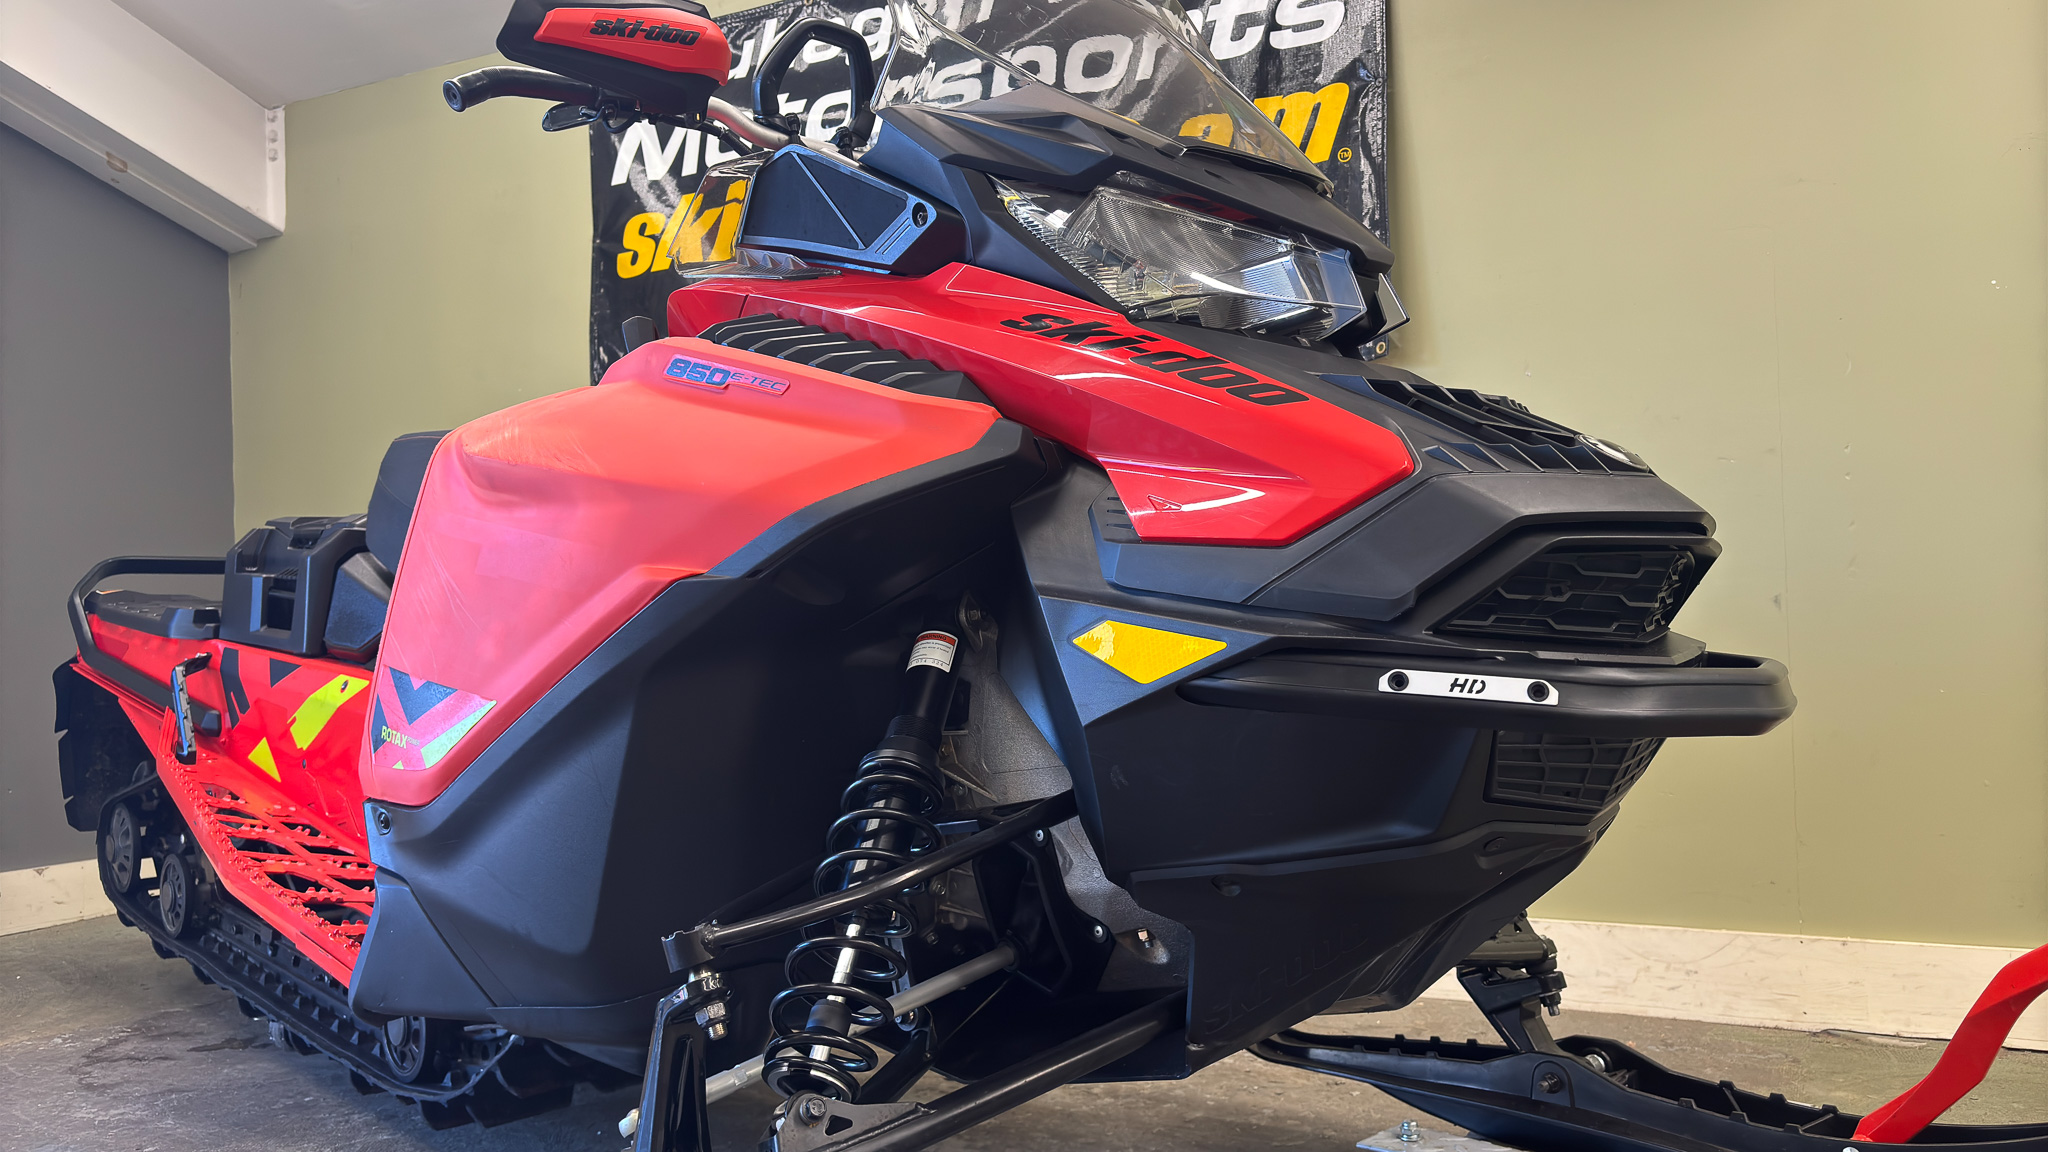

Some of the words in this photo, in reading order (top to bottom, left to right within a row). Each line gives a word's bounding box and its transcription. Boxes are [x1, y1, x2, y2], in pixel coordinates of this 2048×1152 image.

[589, 18, 701, 46] ski-doo
[666, 357, 732, 386] 850
[1000, 312, 1311, 406] ski-doo
[1448, 677, 1487, 695] HD
[381, 725, 407, 749] ROTAX
